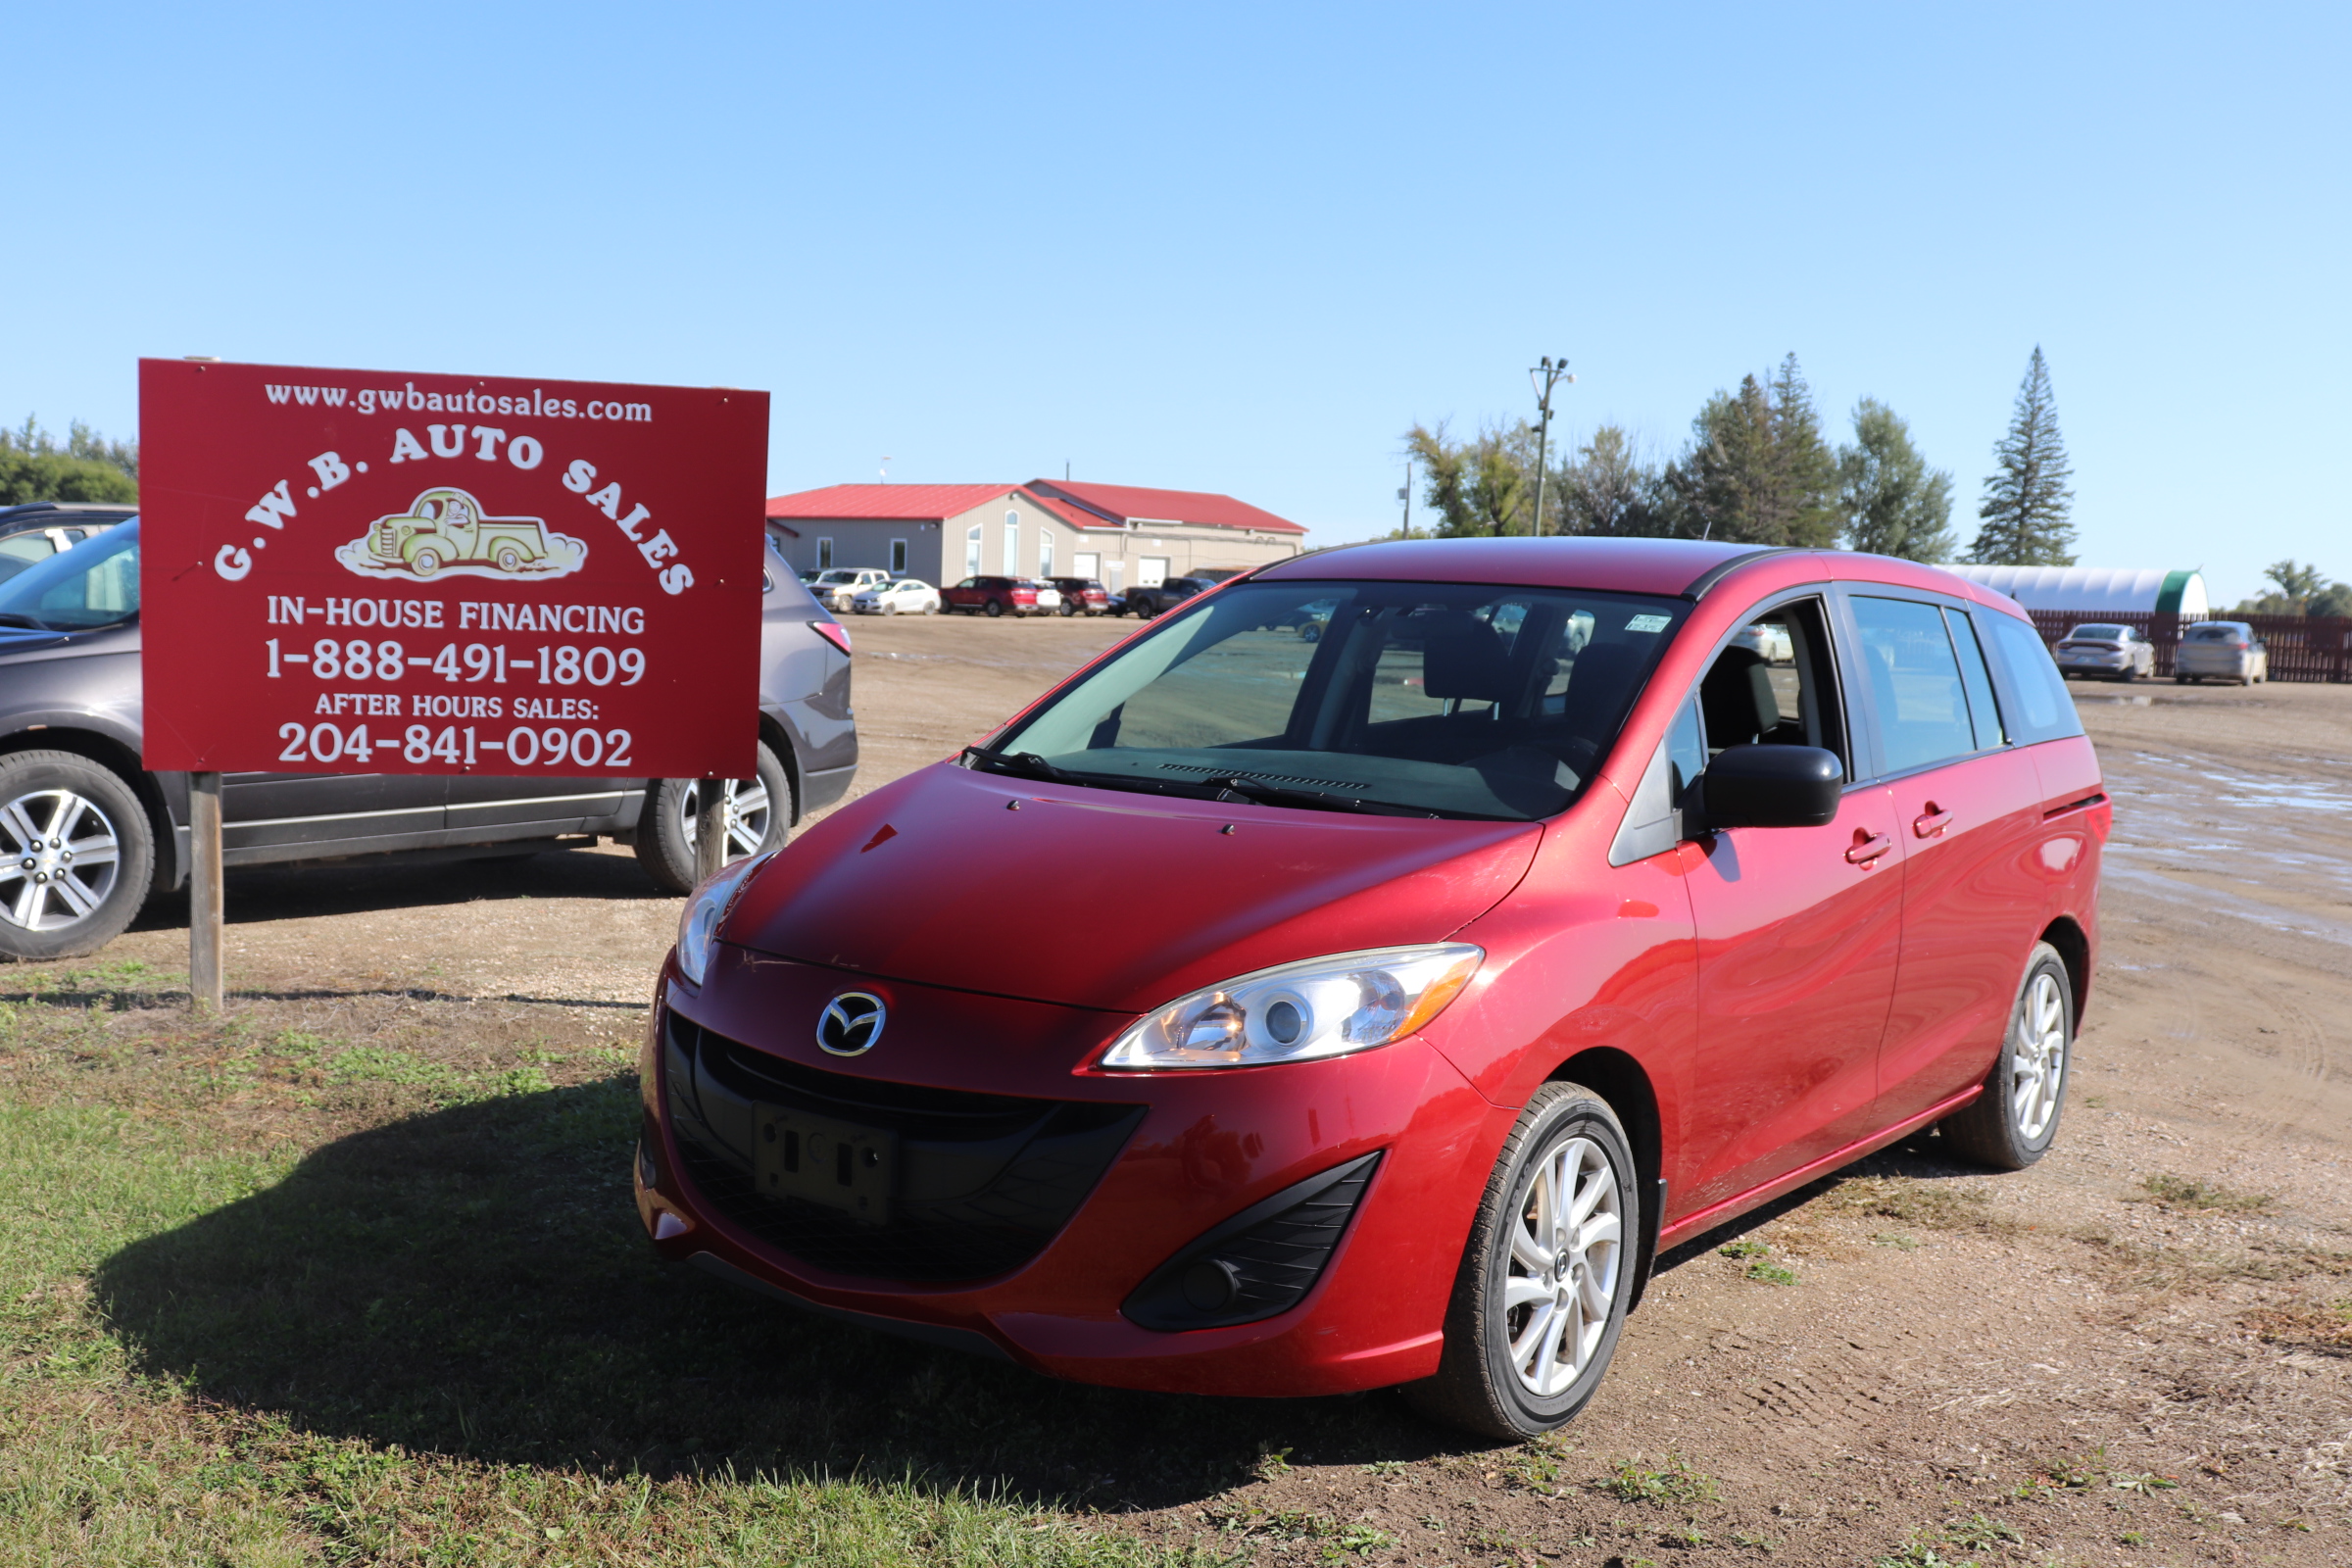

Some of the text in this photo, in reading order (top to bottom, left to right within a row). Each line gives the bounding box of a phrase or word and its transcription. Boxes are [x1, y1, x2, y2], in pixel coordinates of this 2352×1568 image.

[265, 381, 653, 422] www.gwbautosales.com
[214, 423, 695, 596] G.W.B. AUTO SALES
[267, 595, 645, 635] IN-HOUSE FINANCING
[265, 638, 646, 687] 1-888-491-1809
[314, 693, 599, 720] AFTER HOURS SALES:
[278, 721, 632, 767] 204-841-0902
